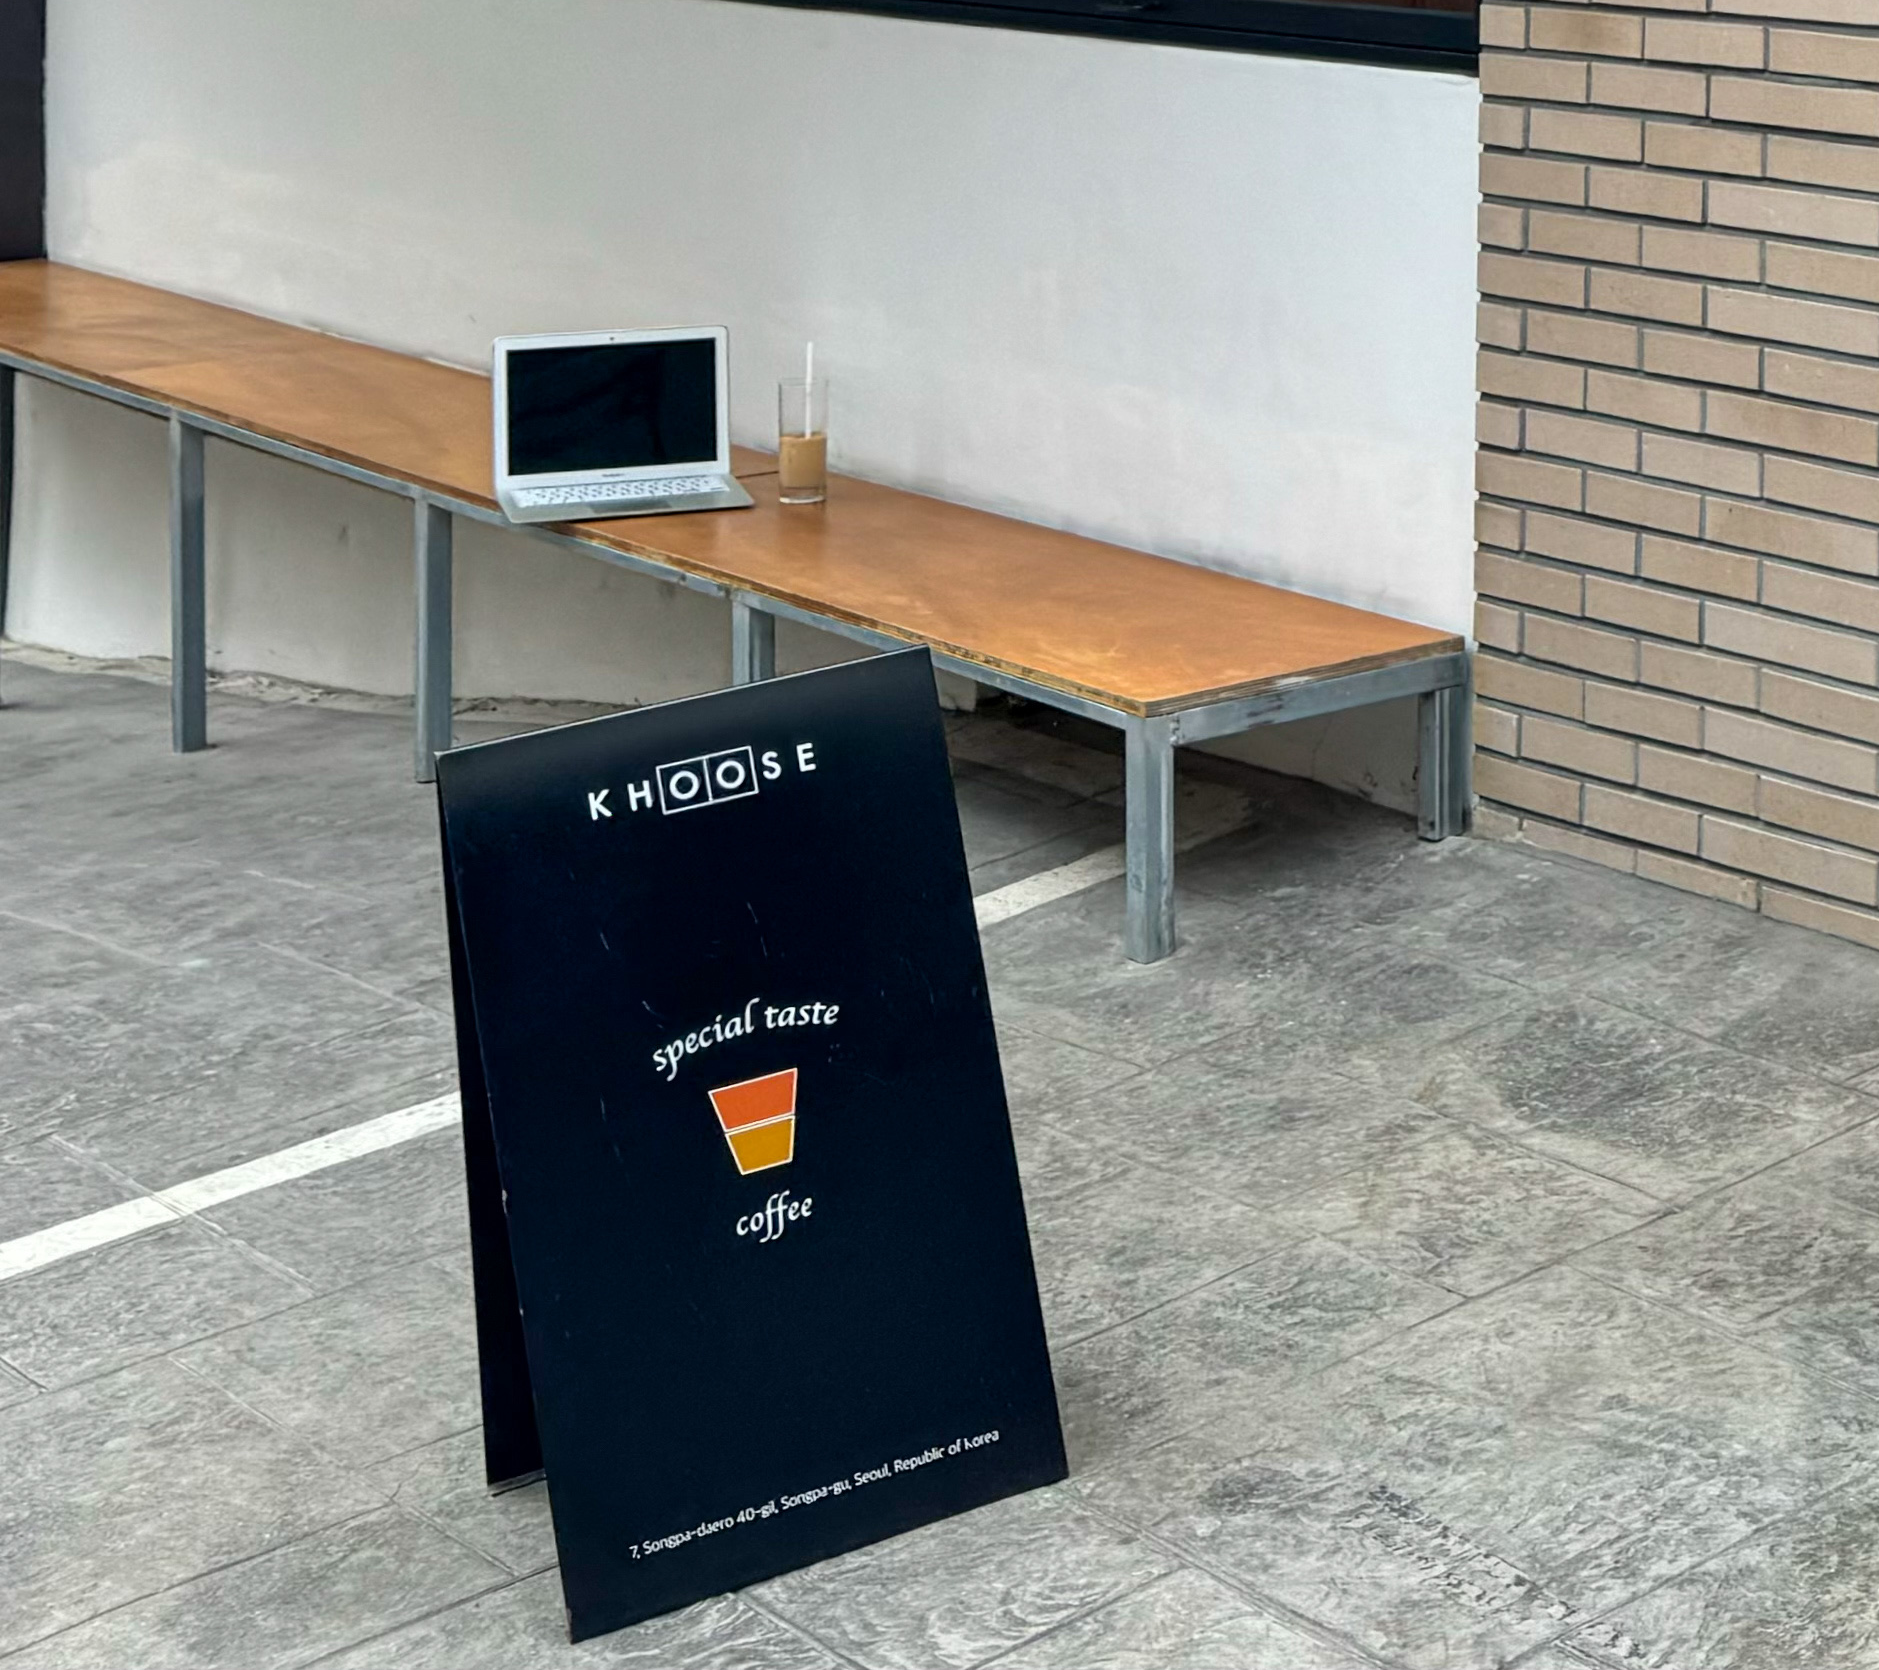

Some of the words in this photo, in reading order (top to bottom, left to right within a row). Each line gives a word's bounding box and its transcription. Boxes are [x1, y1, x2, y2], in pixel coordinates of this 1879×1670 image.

[587, 742, 817, 821] KHOOSE
[652, 997, 758, 1082] special
[764, 1001, 840, 1029] taste
[736, 1190, 813, 1243] coffee
[642, 1516, 735, 1555] Songpa-daero
[780, 1479, 853, 1510] Songpa-gu,
[853, 1463, 892, 1487] Seoul,
[893, 1447, 946, 1473] Republic
[947, 1438, 962, 1456] of
[963, 1430, 1000, 1451] Korea
